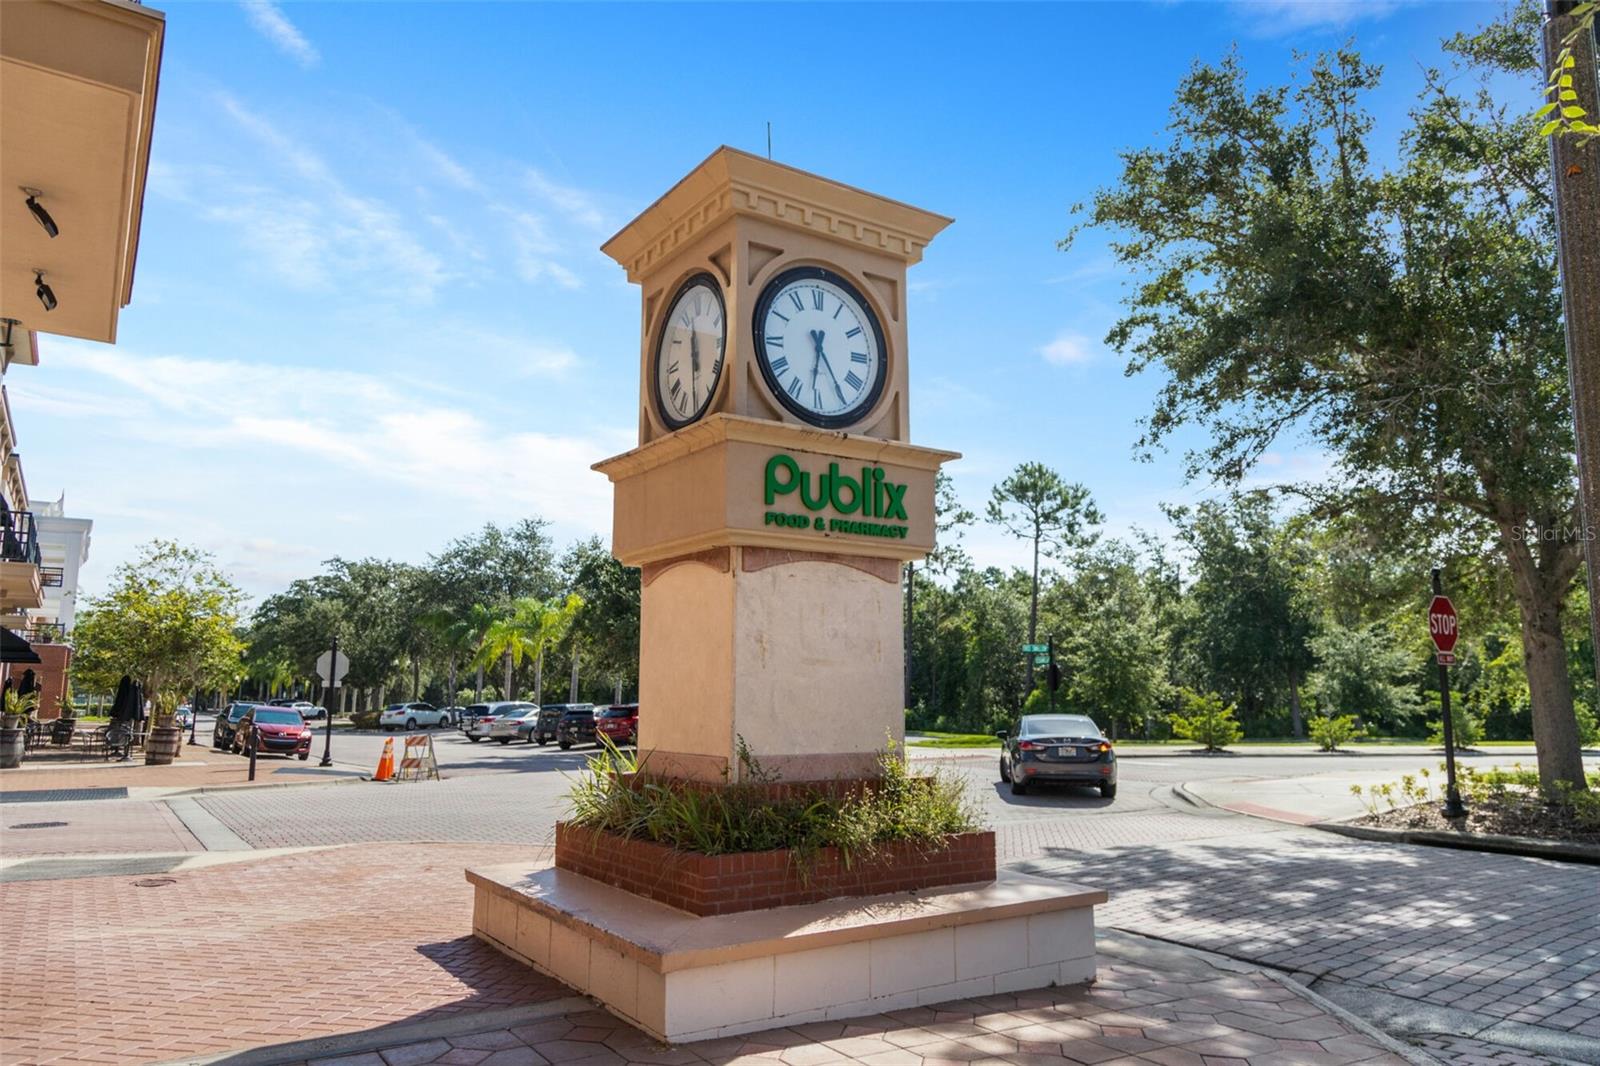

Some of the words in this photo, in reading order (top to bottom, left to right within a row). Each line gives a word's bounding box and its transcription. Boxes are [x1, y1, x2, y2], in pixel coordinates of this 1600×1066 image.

[764, 454, 908, 520] Publix
[765, 512, 810, 529] FOOD
[814, 517, 825, 531] &
[830, 519, 909, 539] PHARMACY
[1430, 613, 1456, 635] STOP
